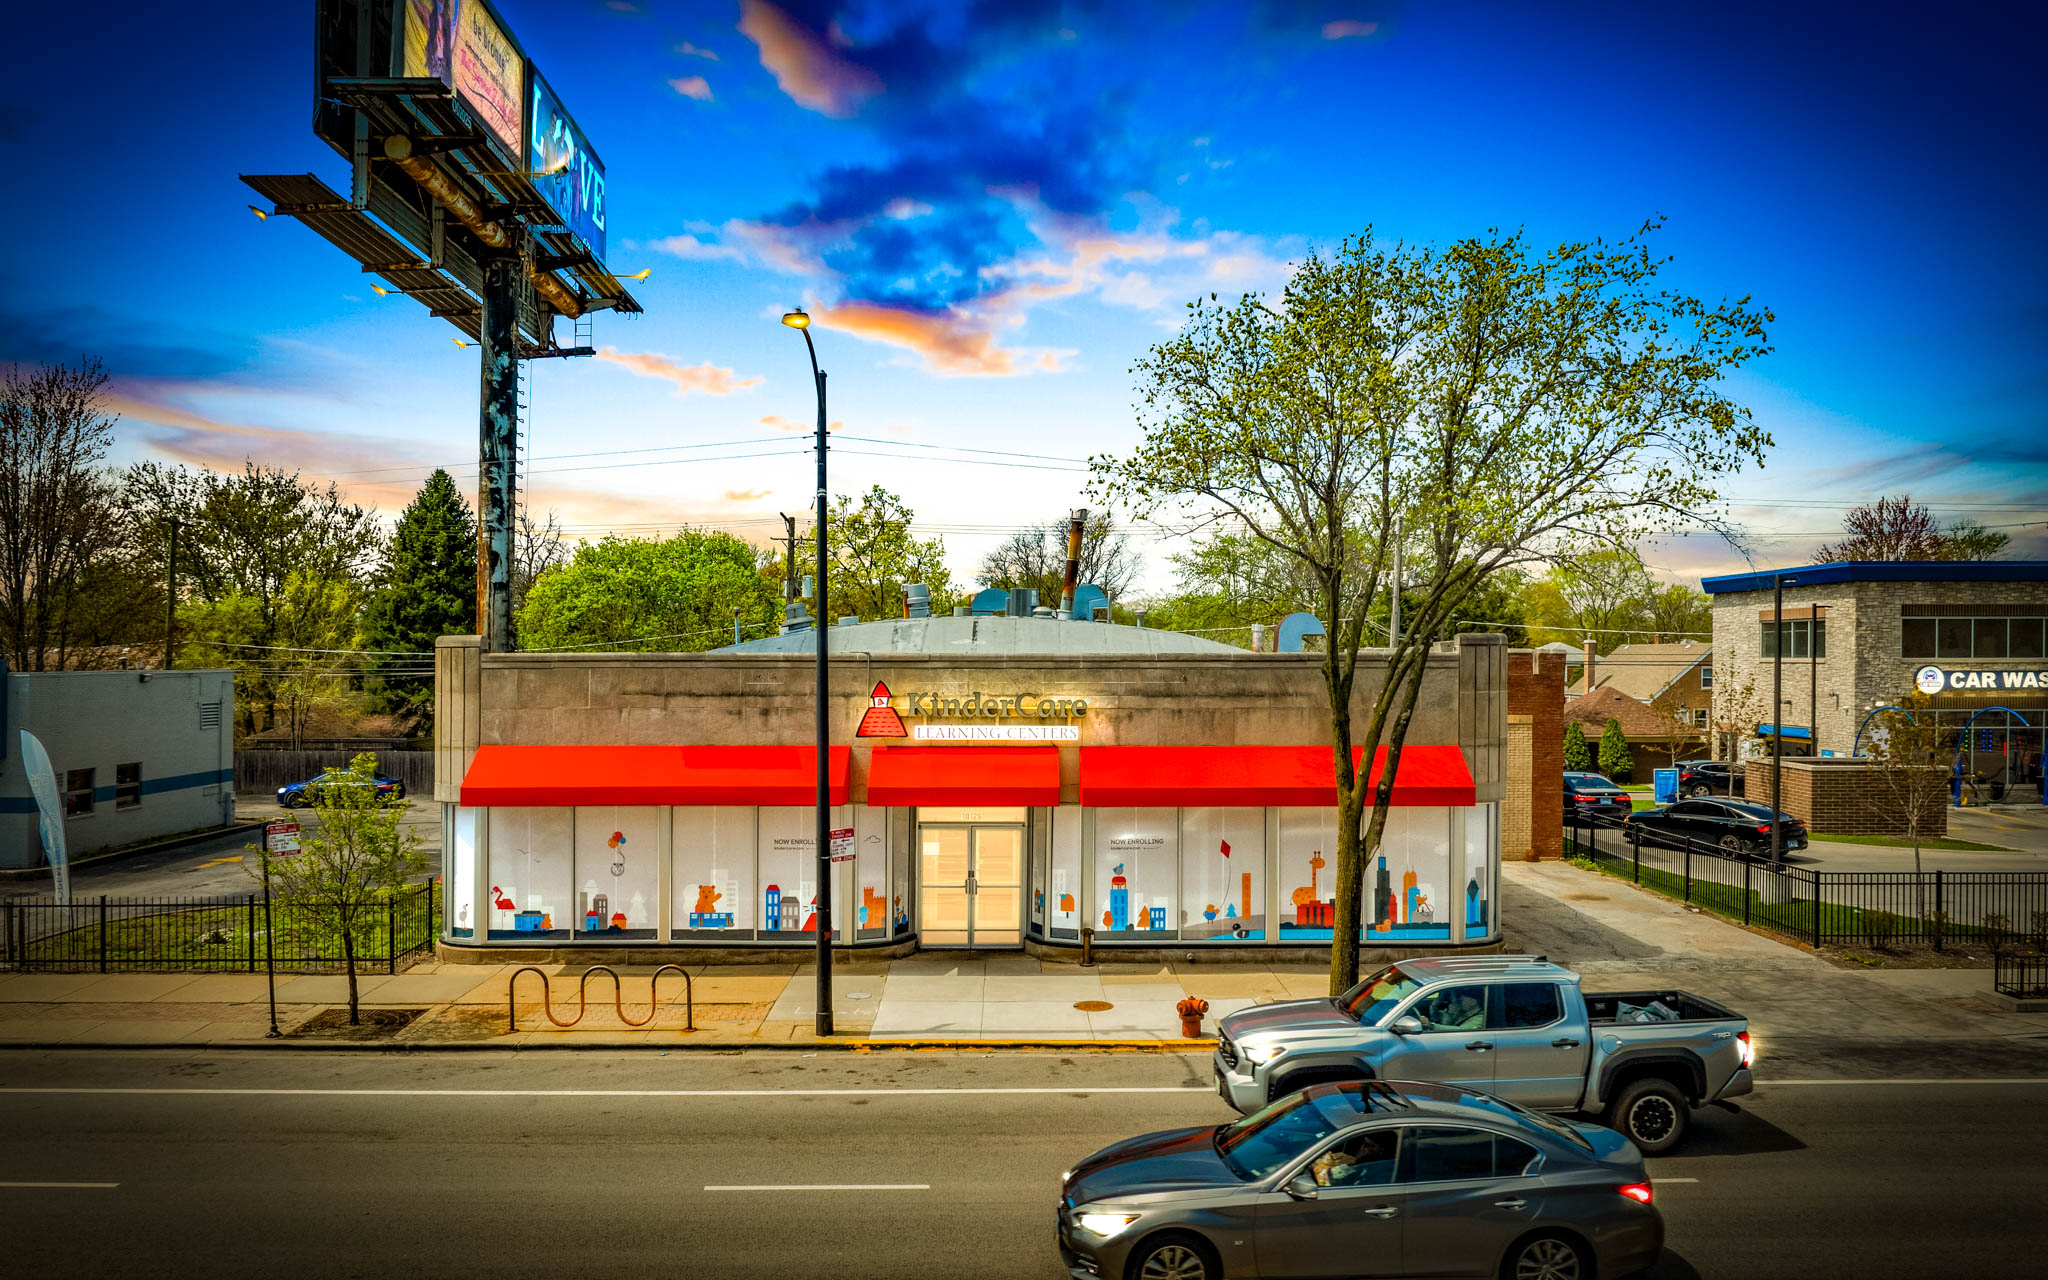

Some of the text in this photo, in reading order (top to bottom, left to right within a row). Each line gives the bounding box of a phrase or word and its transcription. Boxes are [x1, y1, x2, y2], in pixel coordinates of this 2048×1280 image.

[1949, 671, 2048, 689] CAR WAS
[907, 691, 1088, 718] KinderCare
[917, 727, 1077, 739] LEARNING CENTERS
